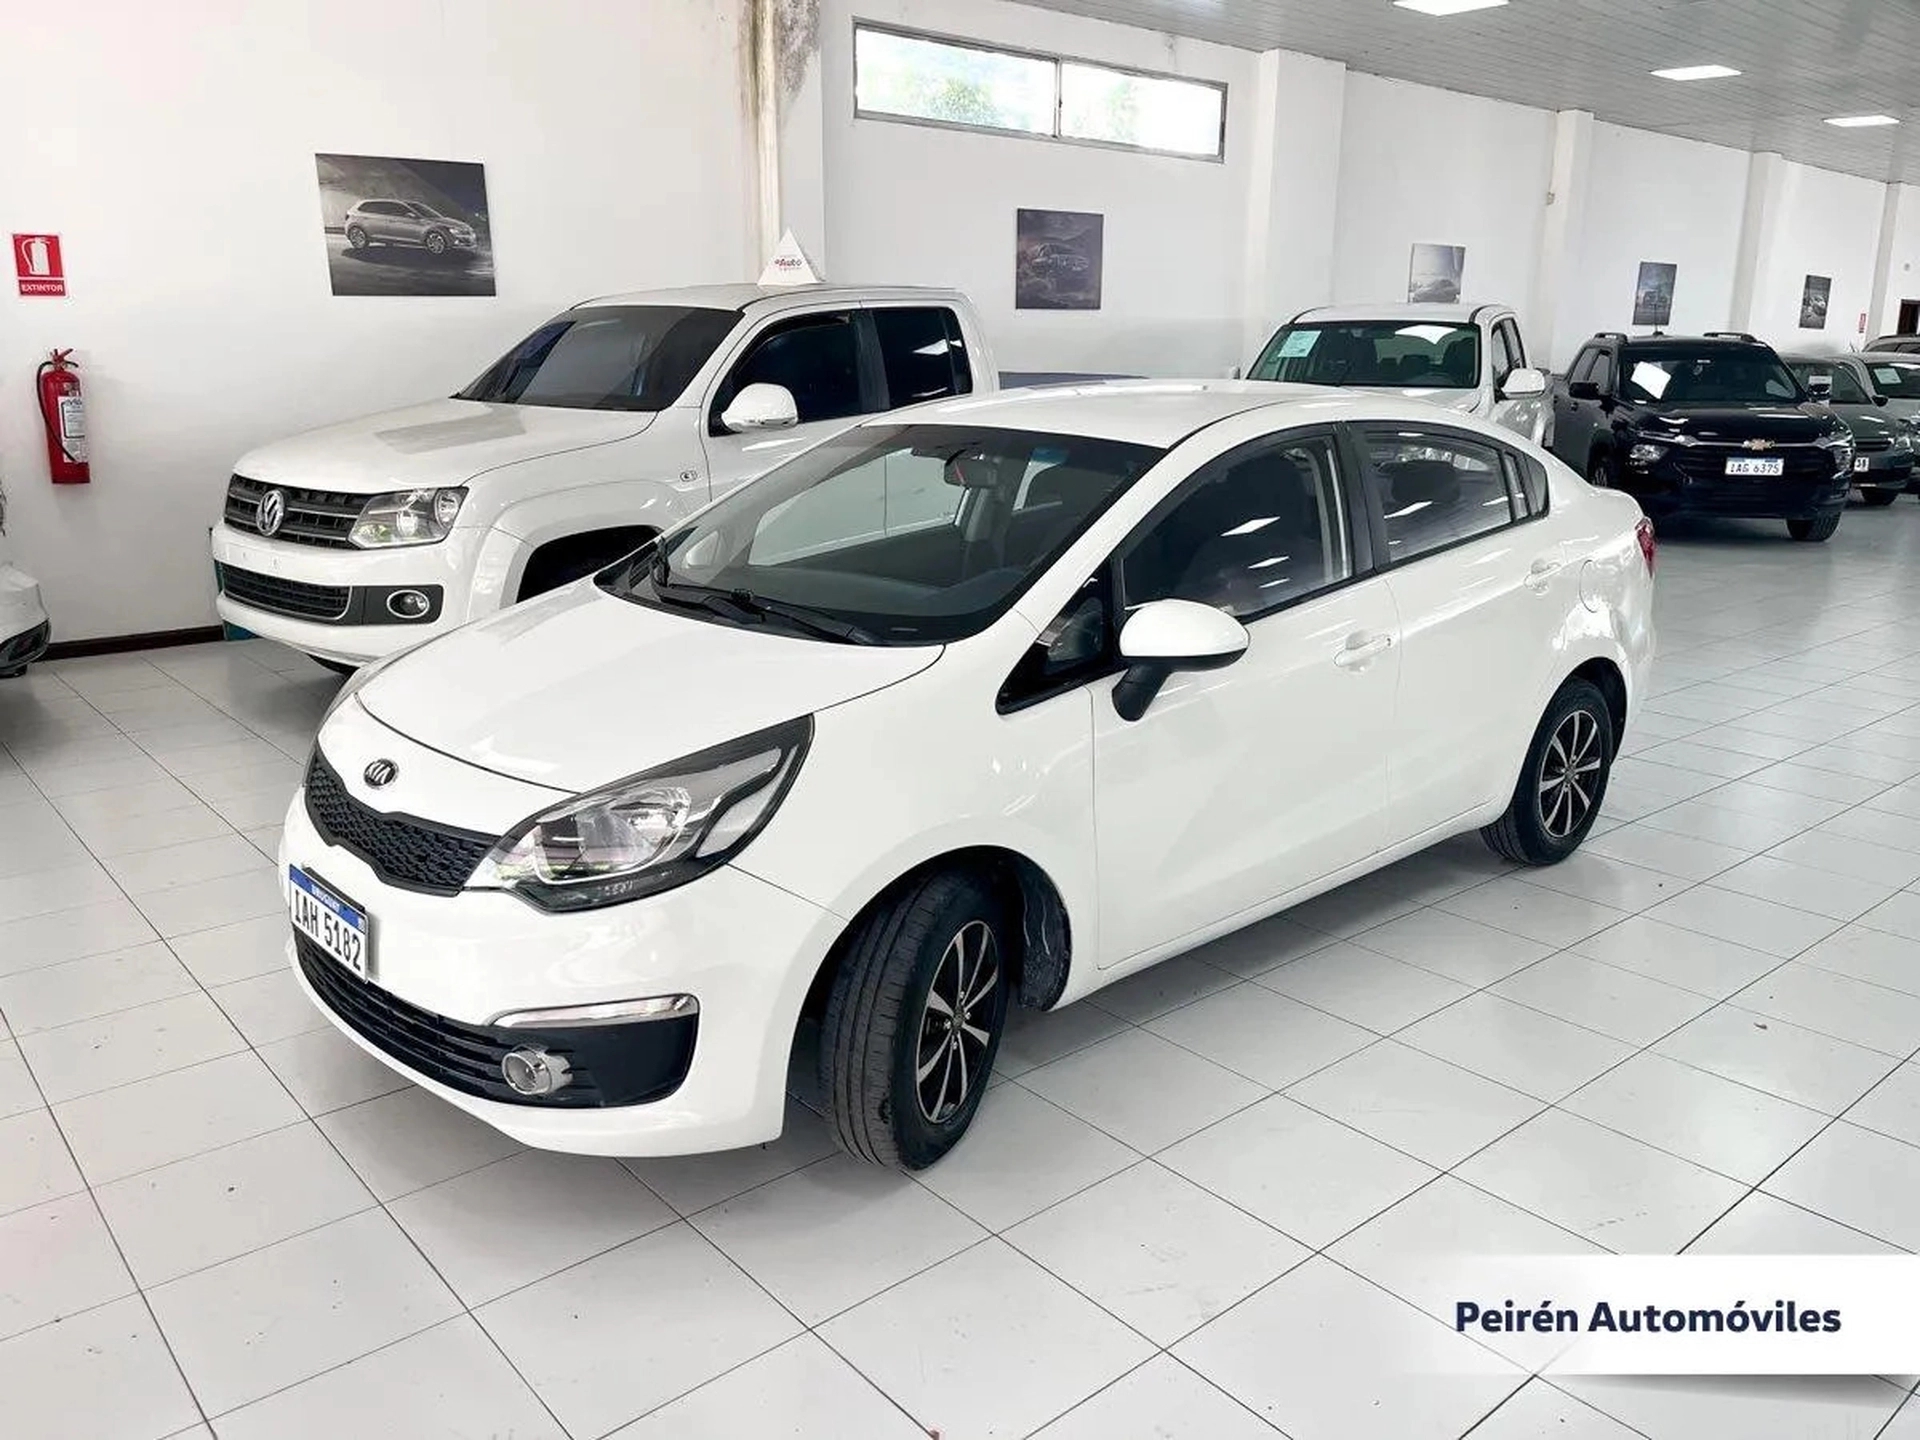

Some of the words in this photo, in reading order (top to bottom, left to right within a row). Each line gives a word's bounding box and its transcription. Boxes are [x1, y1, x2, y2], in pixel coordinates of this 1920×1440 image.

[21, 284, 64, 292] EXTINTOR
[1753, 463, 1780, 474] 6375
[295, 889, 319, 938] IAH
[324, 911, 361, 972] 5182
